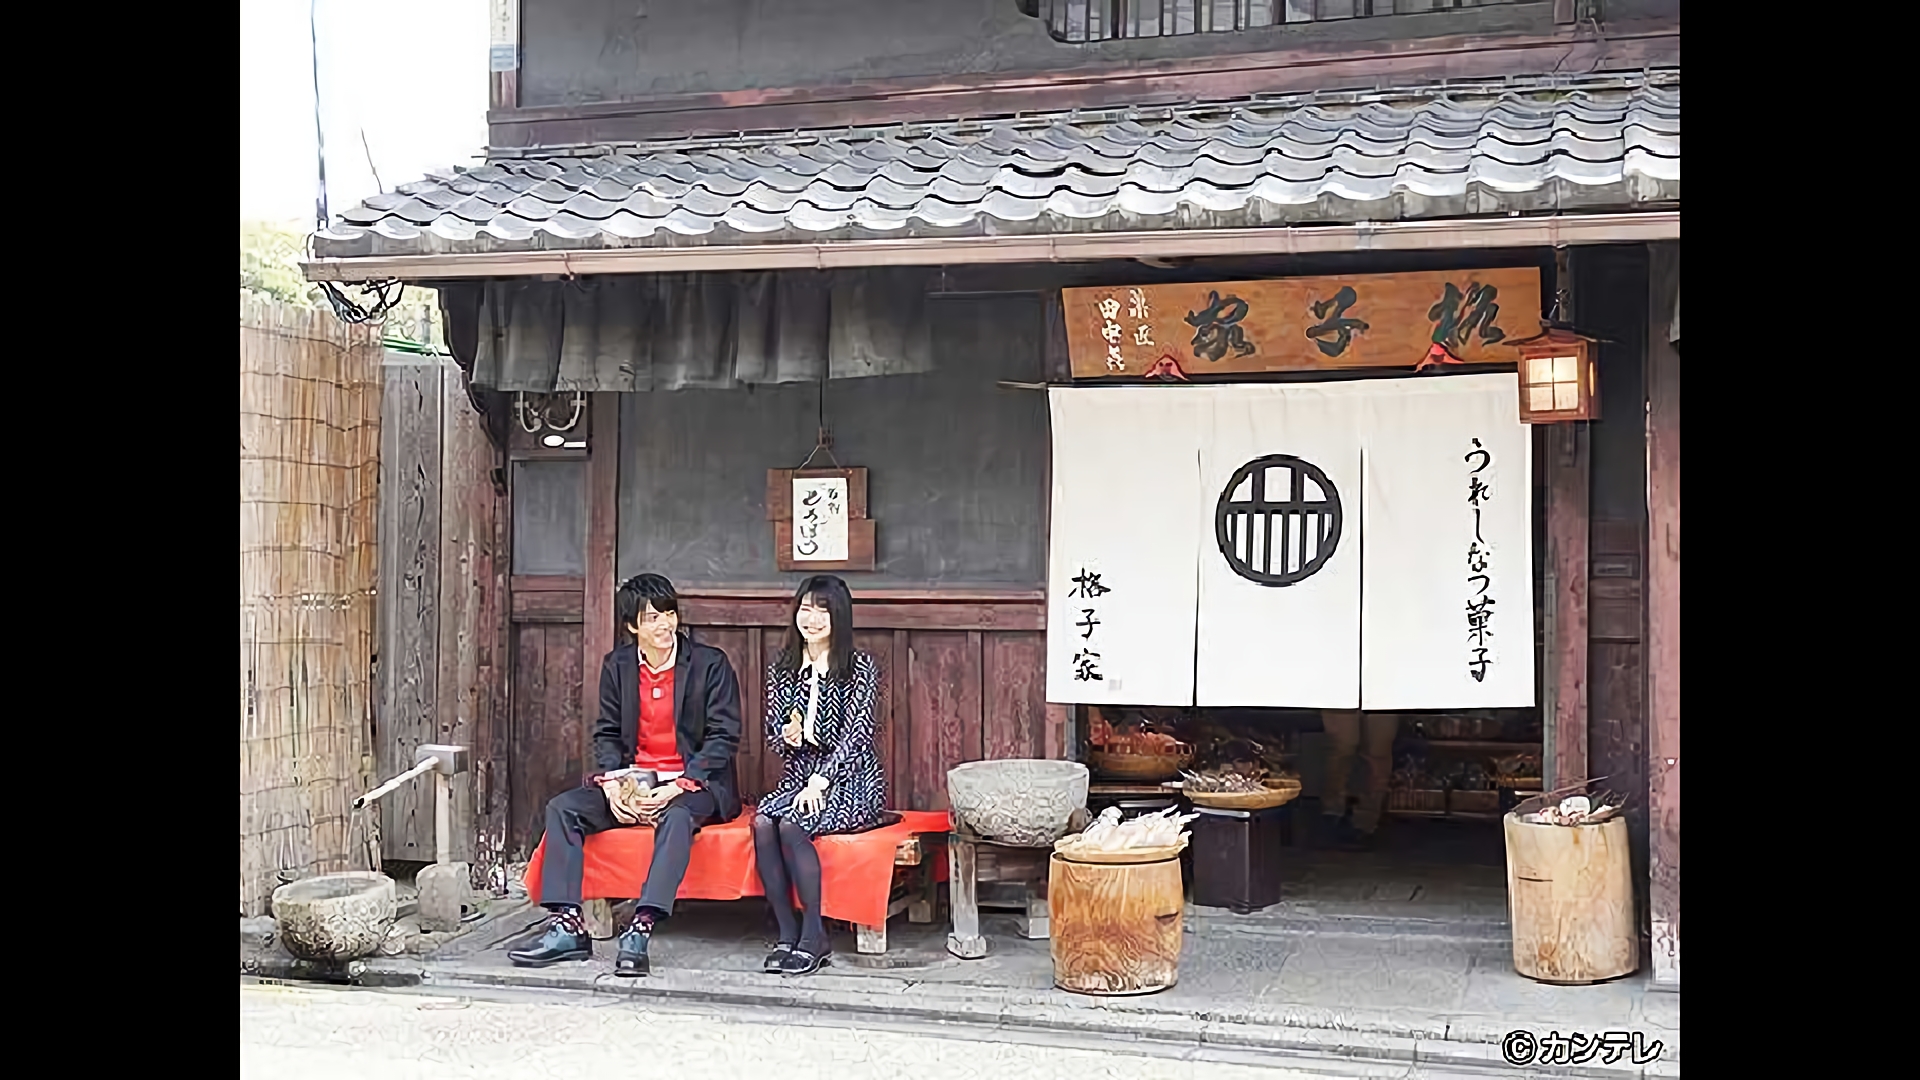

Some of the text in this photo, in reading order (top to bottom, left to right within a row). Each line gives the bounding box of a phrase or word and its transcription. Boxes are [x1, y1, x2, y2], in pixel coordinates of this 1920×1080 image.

[1068, 567, 1111, 681] 格子家
[1464, 438, 1496, 682] うれしなつ菓子
